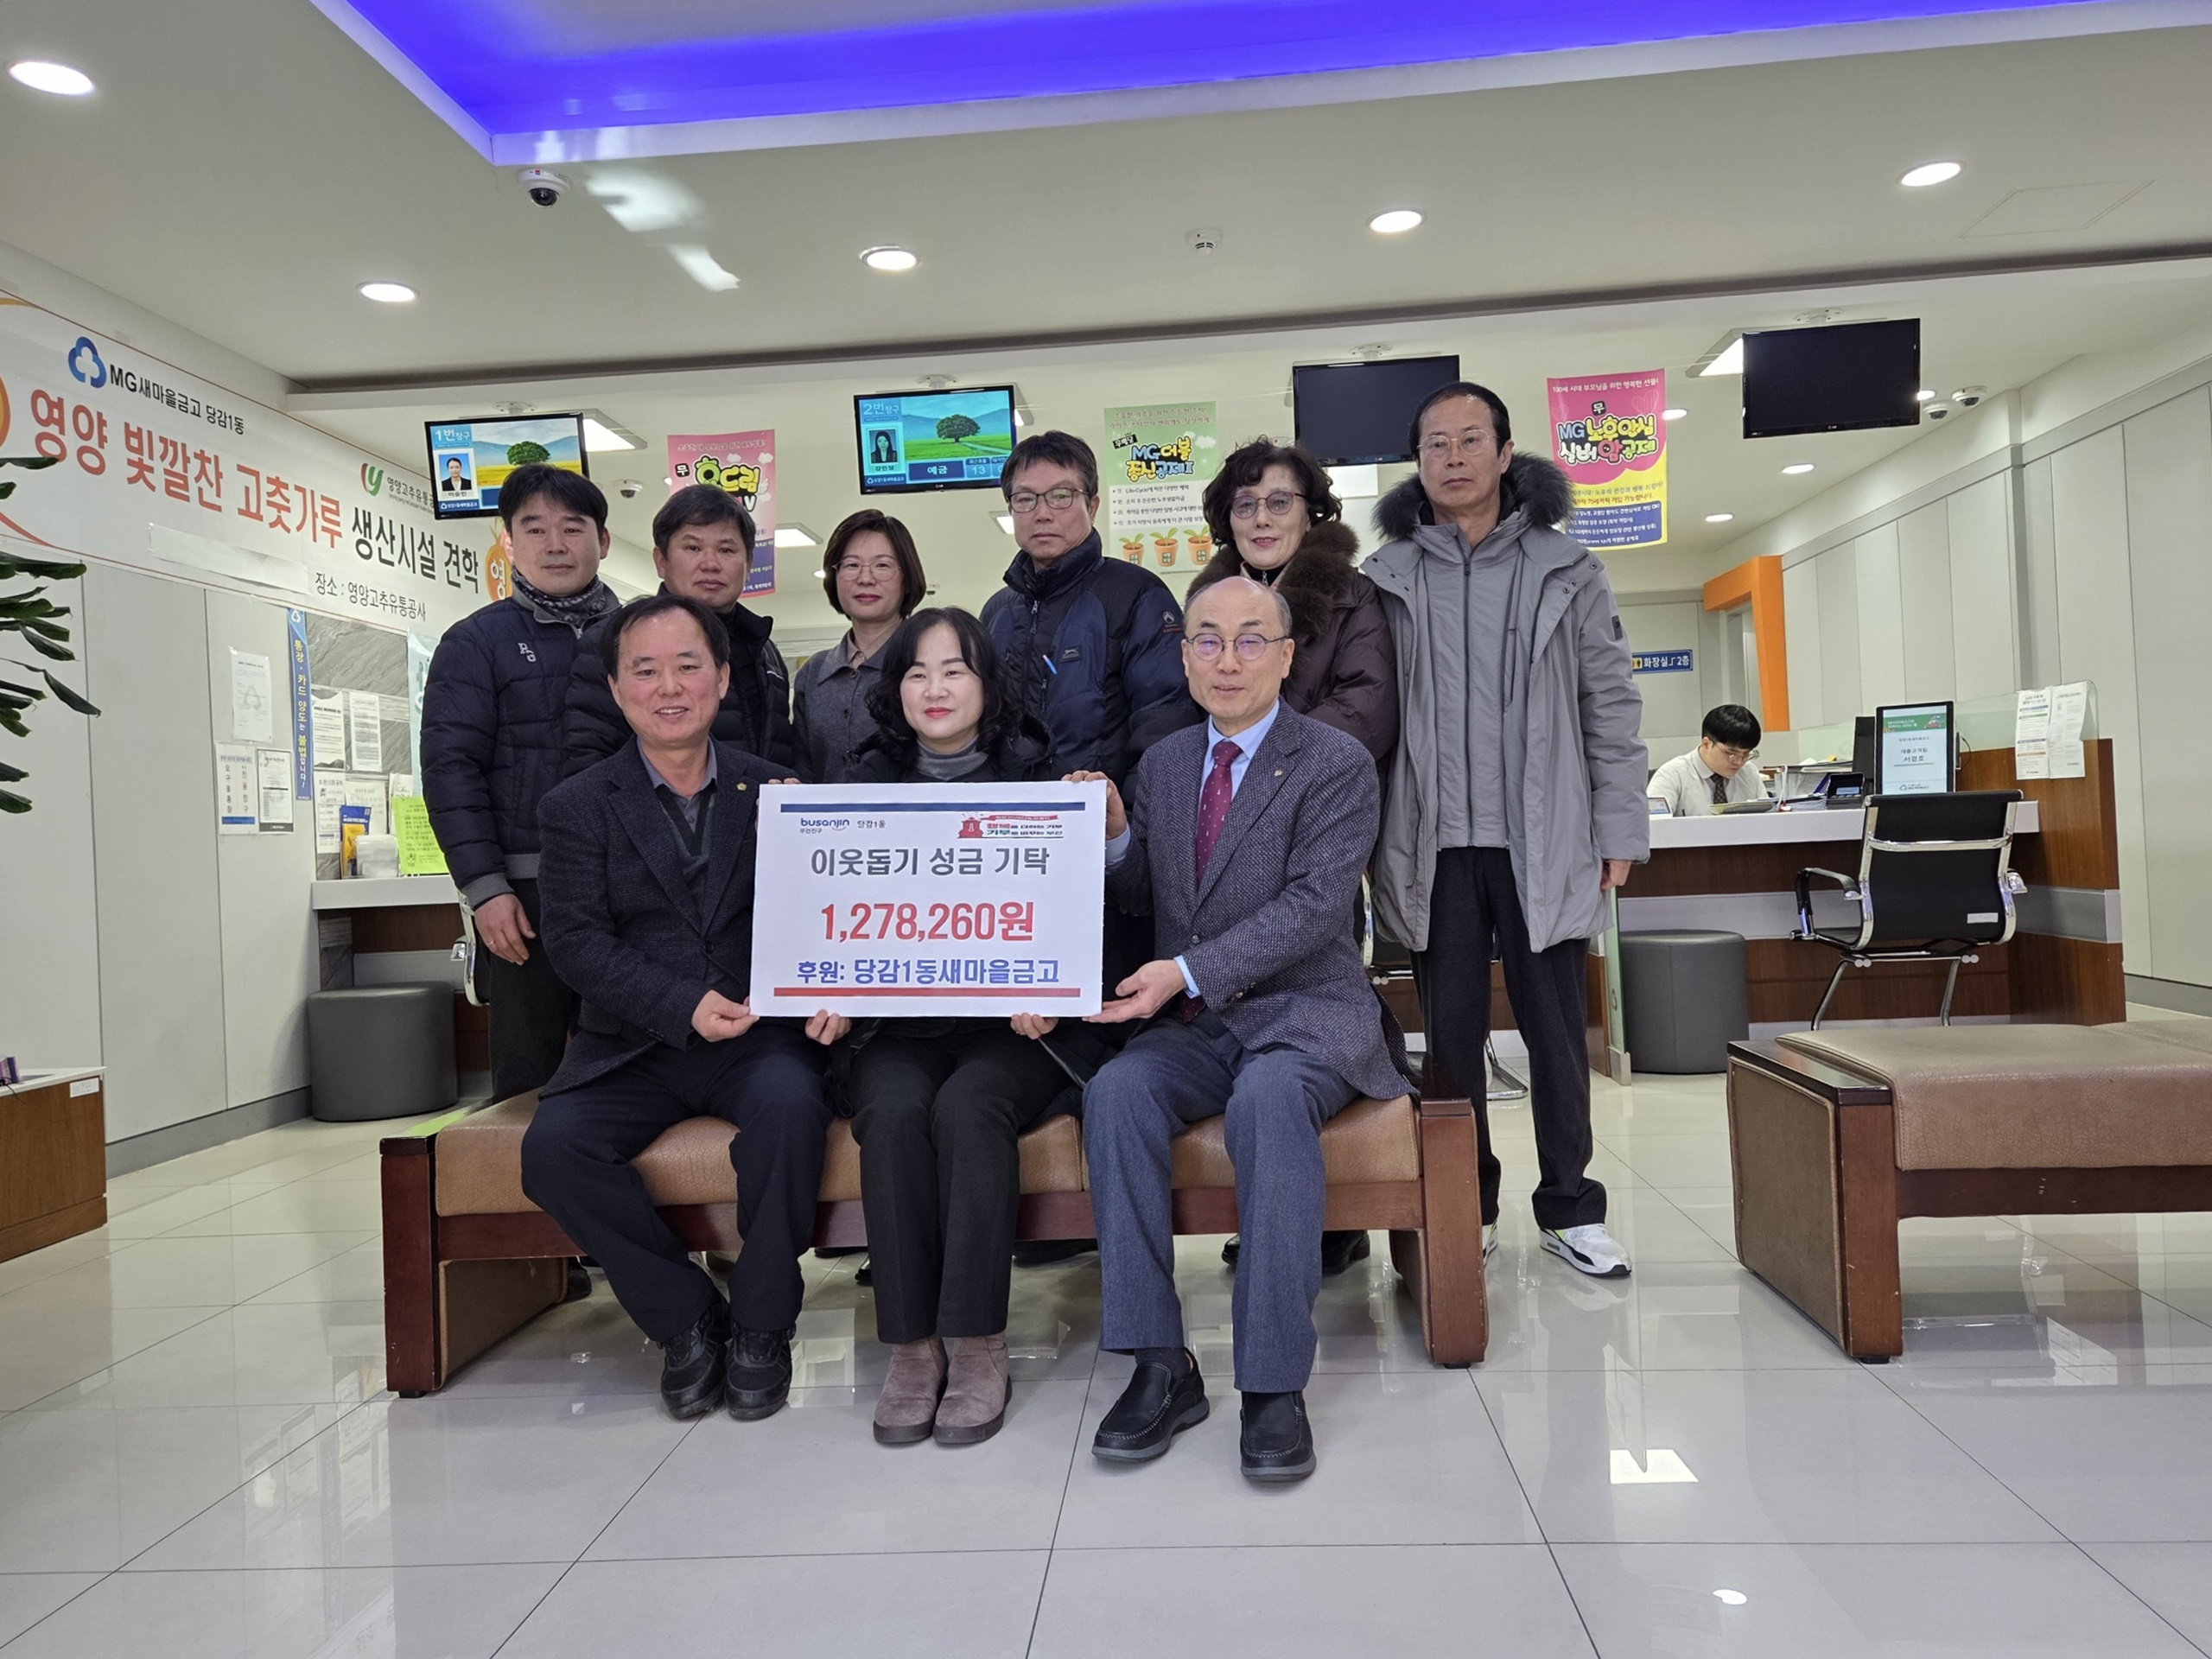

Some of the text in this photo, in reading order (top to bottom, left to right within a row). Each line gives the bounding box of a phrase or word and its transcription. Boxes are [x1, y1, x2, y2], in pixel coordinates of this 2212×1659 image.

[110, 364, 245, 435] MG새마을금고 당감1동
[1593, 402, 1605, 414] 무
[677, 465, 688, 475] 무
[927, 465, 948, 474] 예금
[972, 466, 986, 474] 13
[30, 389, 479, 594] 영양 빛깔찬 고춧가루 생산시설 견학
[315, 572, 338, 596] 장소
[348, 582, 427, 621] 영양고추유통공사
[1643, 655, 1689, 668] 화장실 2층
[800, 817, 849, 829] busanjin
[857, 820, 886, 829] 당감1동
[810, 848, 1050, 876] 이웃돕기 성금 기탁
[821, 901, 1033, 943] 1,278,260원
[797, 959, 1059, 984] 후원: 당감1동새마을금고
